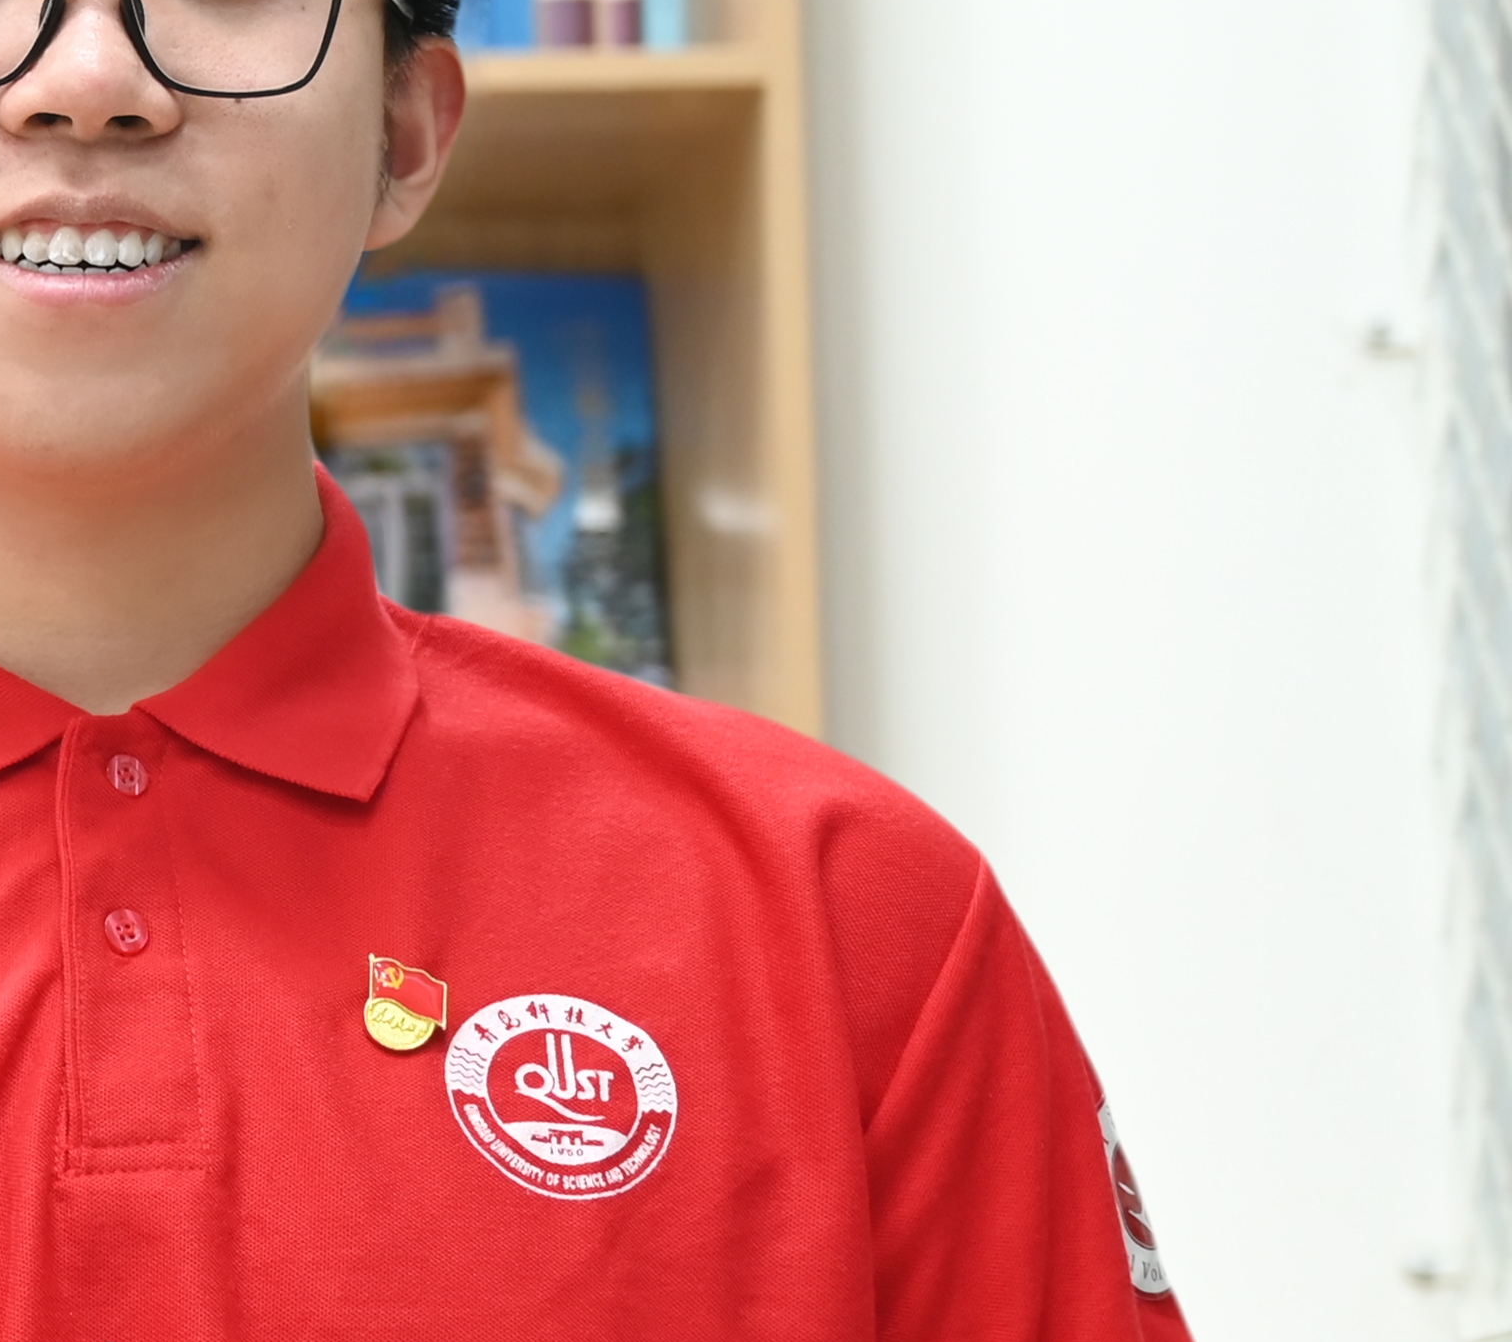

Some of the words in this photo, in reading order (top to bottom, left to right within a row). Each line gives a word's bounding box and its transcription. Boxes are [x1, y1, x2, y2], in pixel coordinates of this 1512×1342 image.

[514, 1033, 614, 1121] QUST
[464, 1104, 496, 1143] QINGDAO
[490, 1139, 545, 1181] UNIVERSITY
[546, 1172, 560, 1187] OF
[562, 1172, 606, 1190] SCIENCE
[605, 1167, 624, 1185] AND
[618, 1123, 662, 1176] TECHNOLOGY
[549, 1146, 584, 1157] 1950
[1142, 1261, 1165, 1282] Vol
